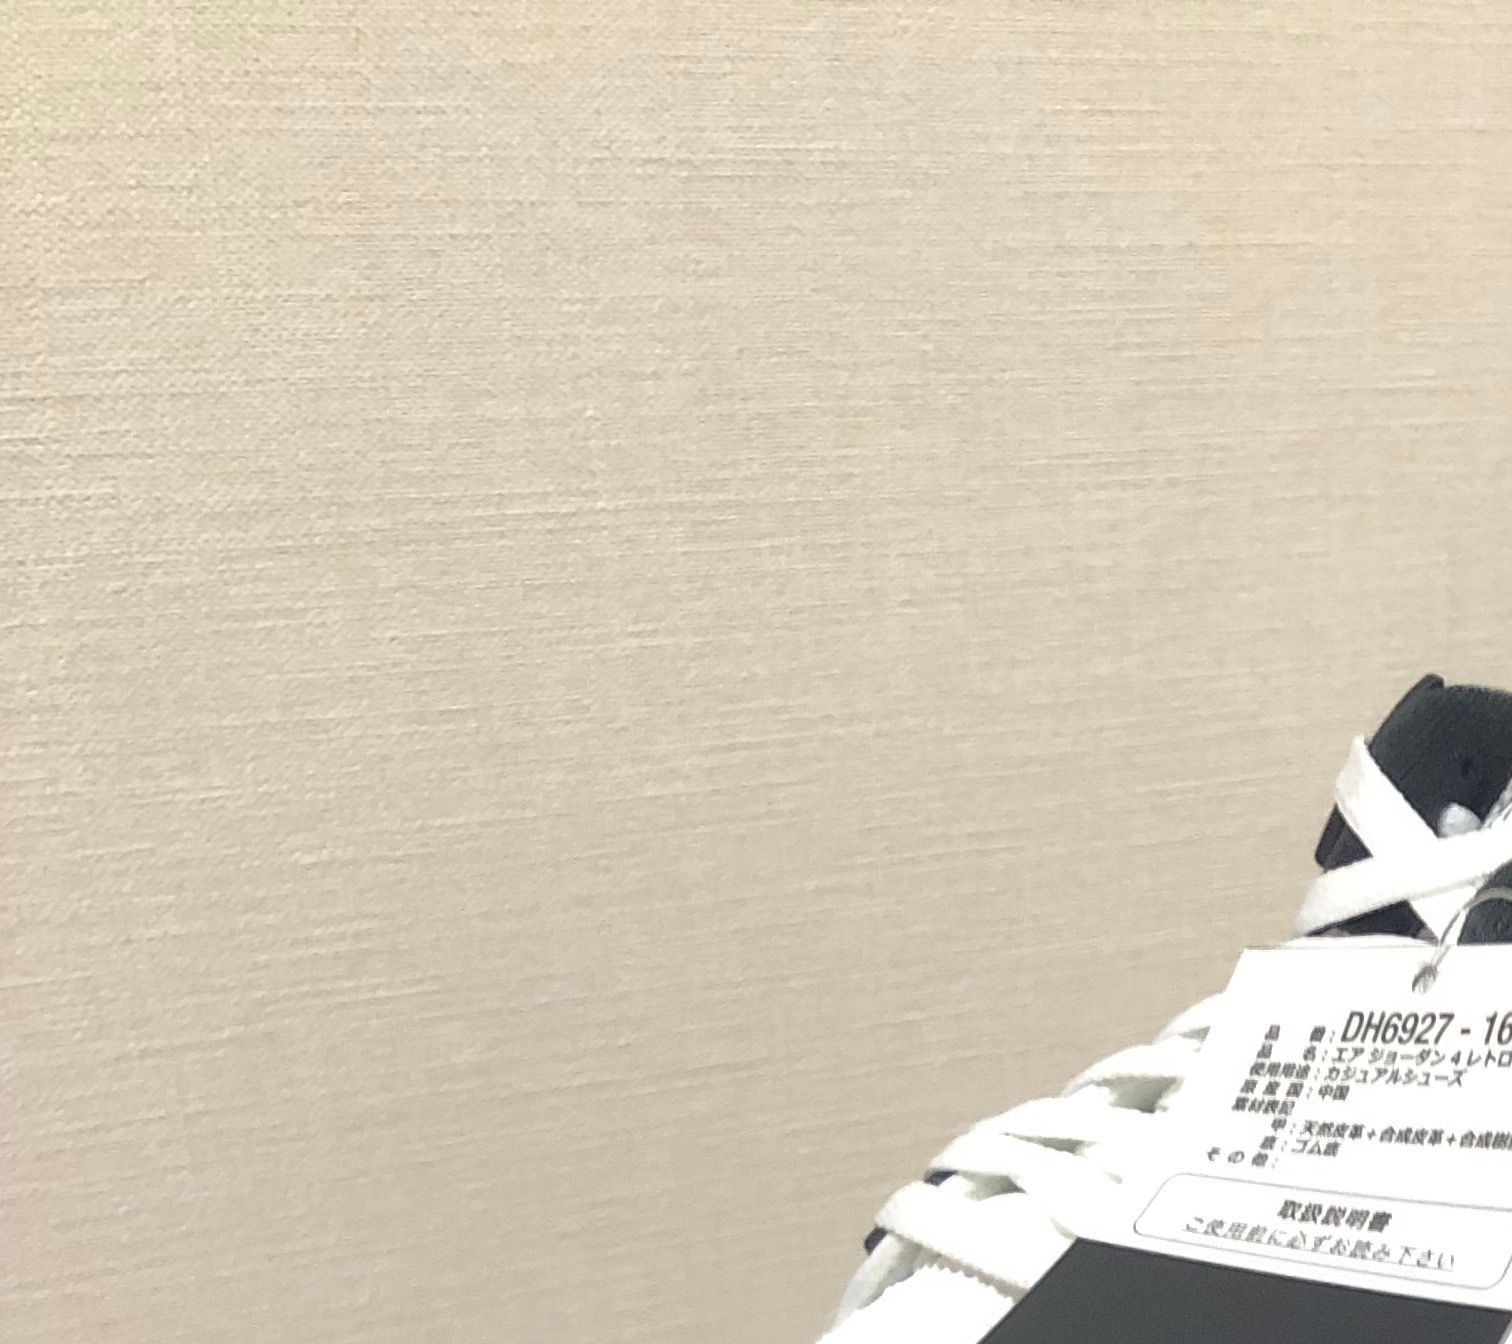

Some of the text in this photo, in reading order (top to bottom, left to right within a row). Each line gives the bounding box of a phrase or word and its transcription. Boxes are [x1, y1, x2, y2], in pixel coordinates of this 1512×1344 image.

[1341, 1010, 1455, 1045] DH6927
[1277, 1199, 1392, 1233] 取扱説明書
